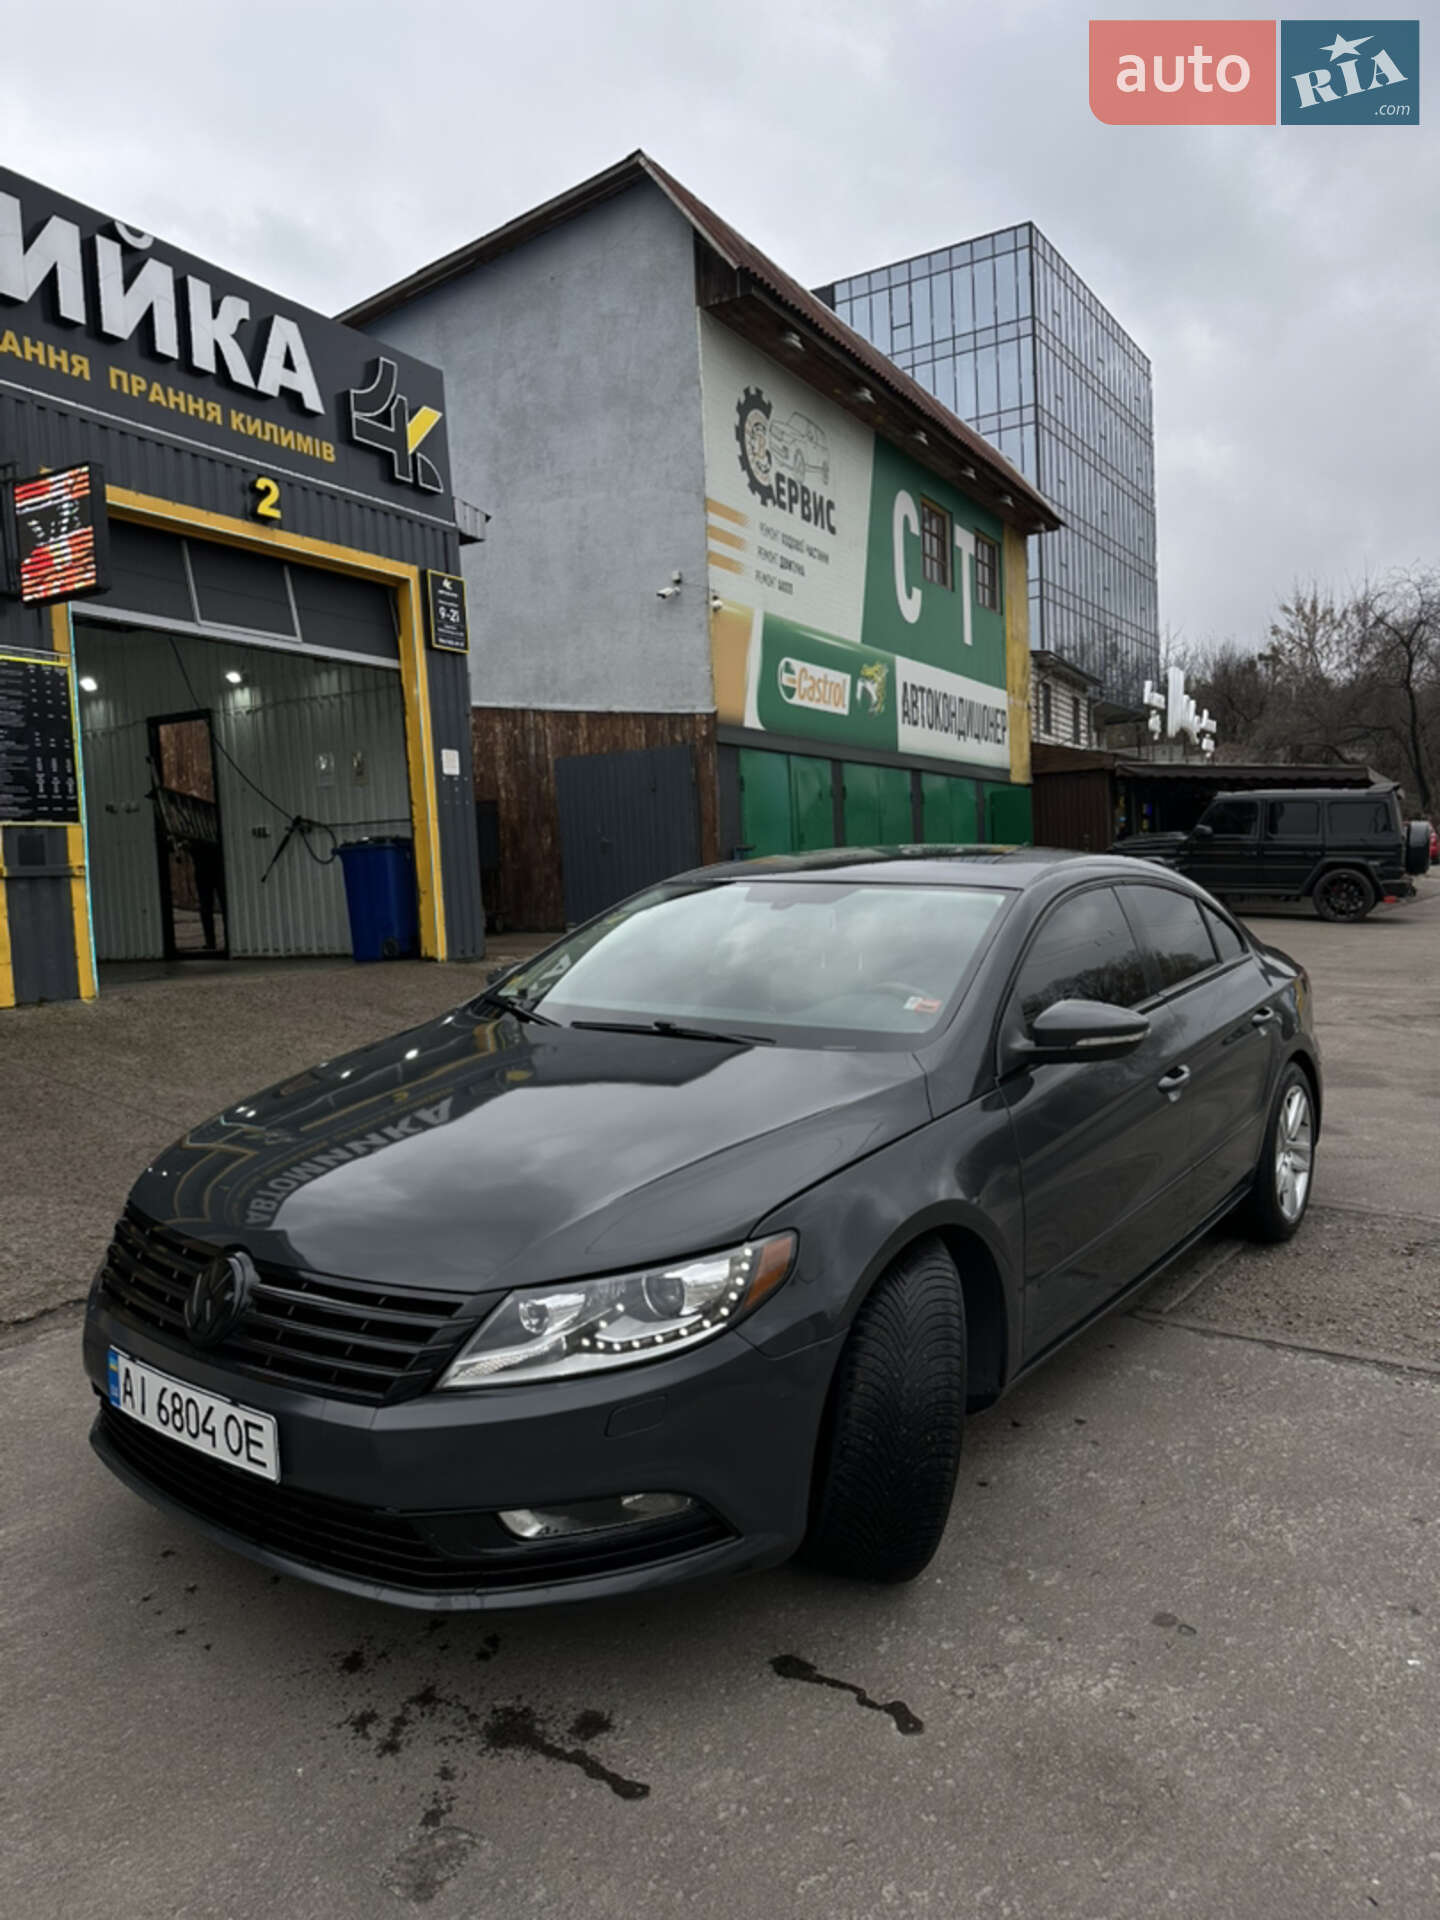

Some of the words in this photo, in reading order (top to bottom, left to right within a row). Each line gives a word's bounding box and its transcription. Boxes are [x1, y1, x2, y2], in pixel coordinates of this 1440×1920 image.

[108, 366, 223, 426] ПРАННЯ
[230, 409, 336, 463] КИЛИМІВ
[255, 477, 281, 519] 2
[797, 666, 847, 710] Castrol
[157, 1387, 217, 1449] 6804
[224, 1414, 268, 1469] OE
